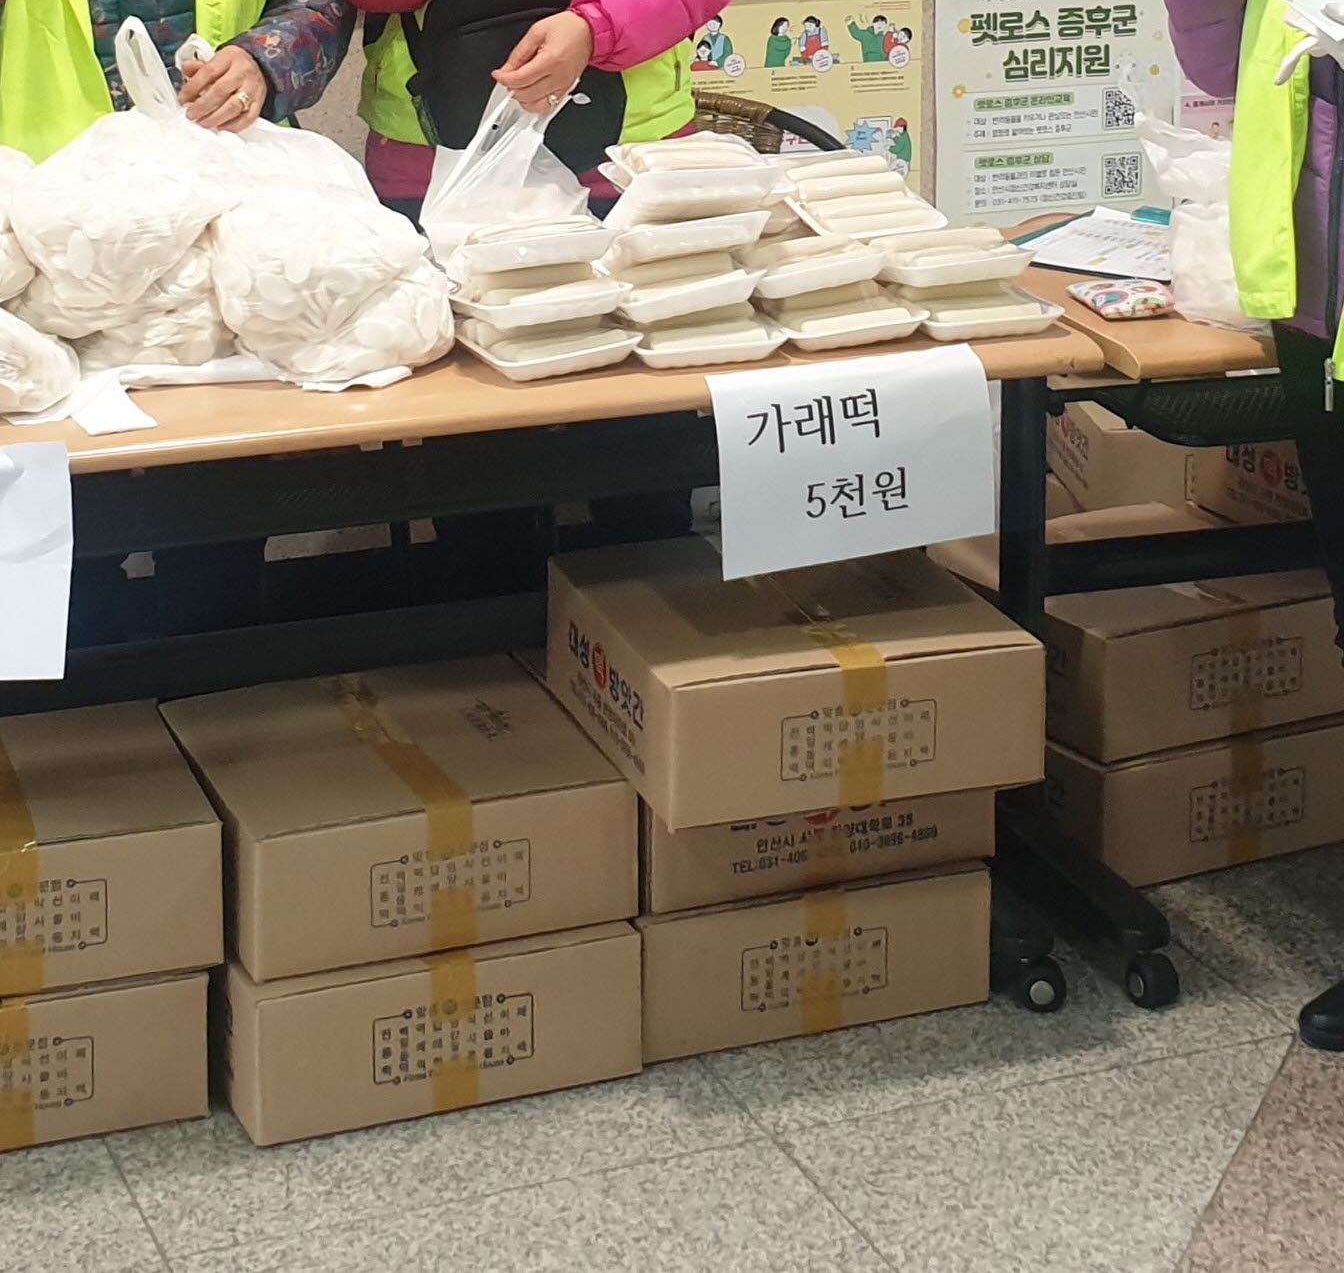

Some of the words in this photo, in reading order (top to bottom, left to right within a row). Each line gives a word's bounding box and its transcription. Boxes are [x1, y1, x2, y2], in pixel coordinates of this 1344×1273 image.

[969, 9, 1051, 45] 펫로스
[1057, 4, 1138, 39] 증후군
[1002, 43, 1111, 81] 심리지원
[745, 387, 881, 454] 가래떡
[805, 466, 909, 519] 5천원
[757, 834, 794, 854] 안산시
